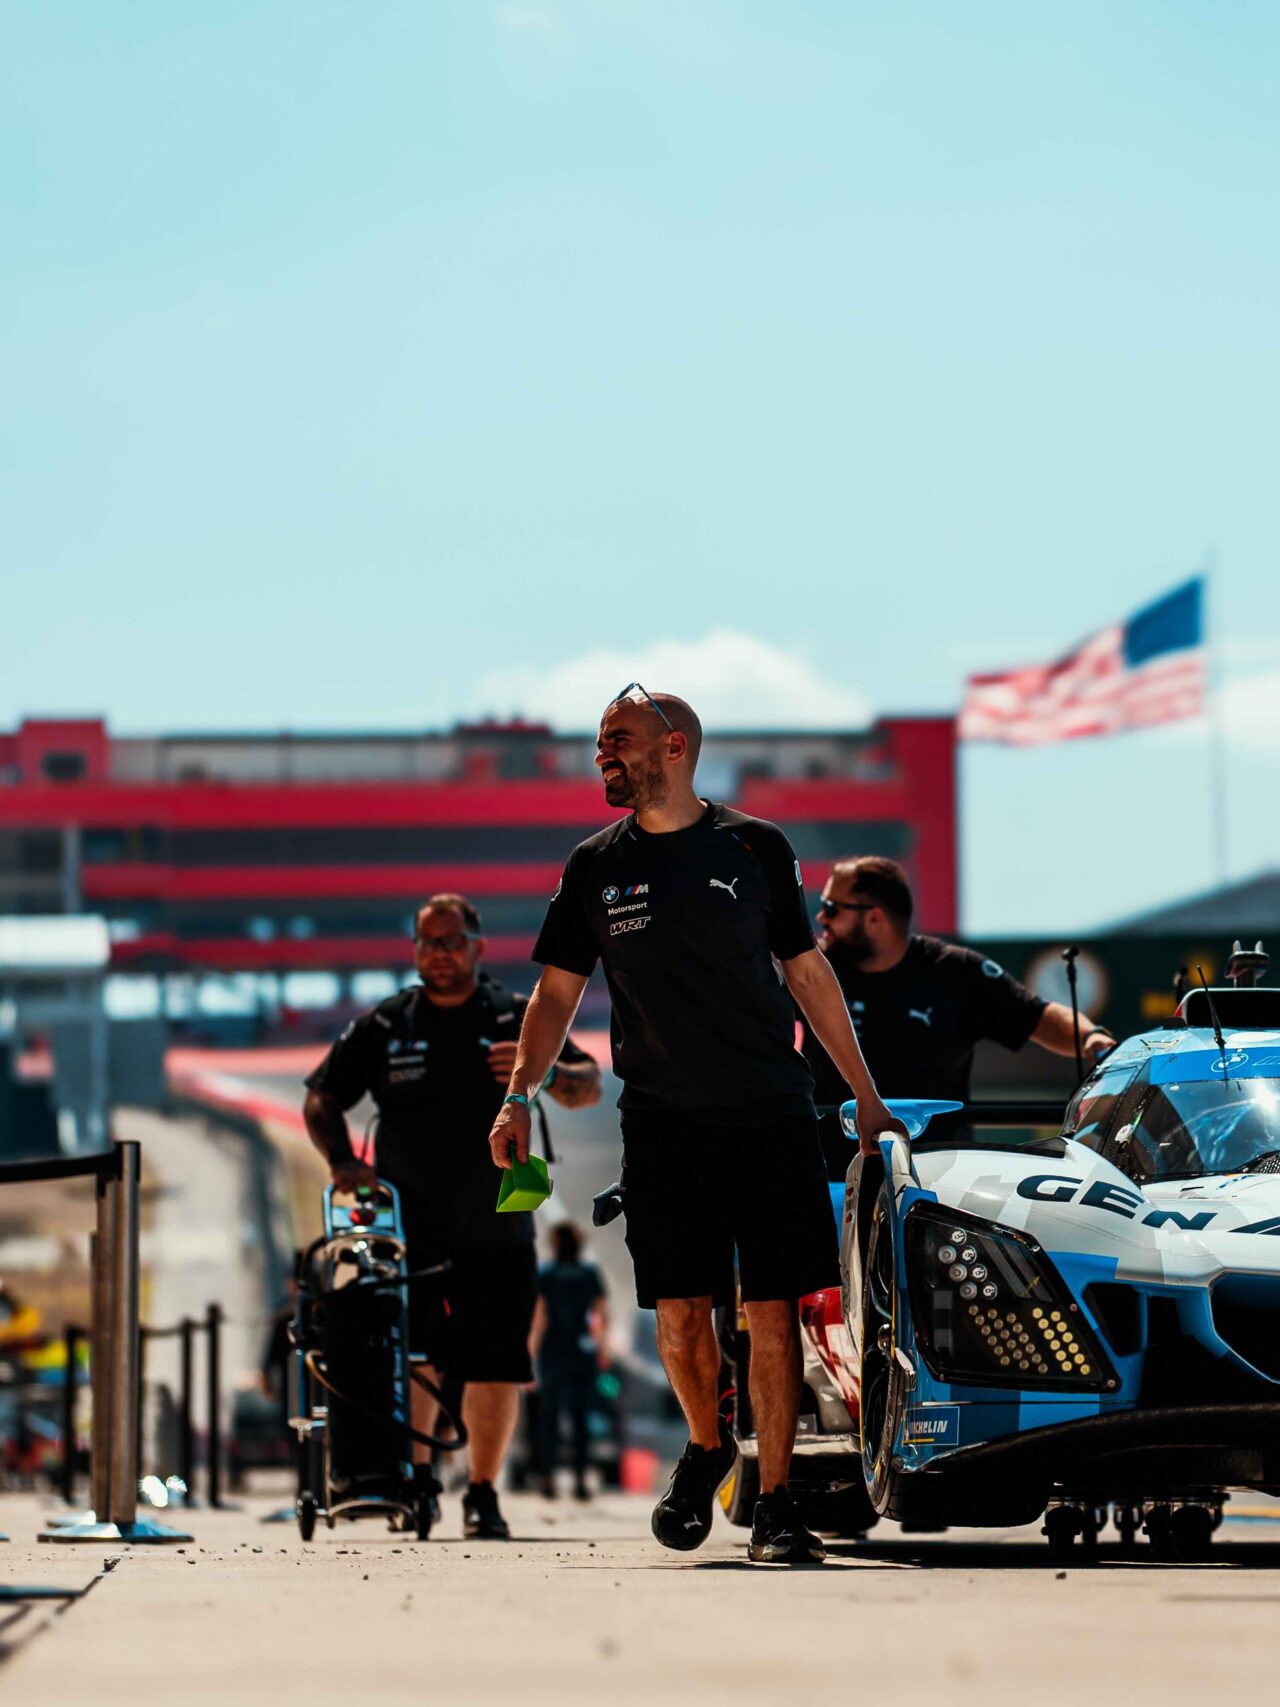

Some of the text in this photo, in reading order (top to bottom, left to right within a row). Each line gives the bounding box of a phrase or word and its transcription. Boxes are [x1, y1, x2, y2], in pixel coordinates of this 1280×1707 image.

[608, 902, 648, 916] Motorsport
[611, 916, 651, 935] WRT
[1016, 1174, 1218, 1231] GEN
